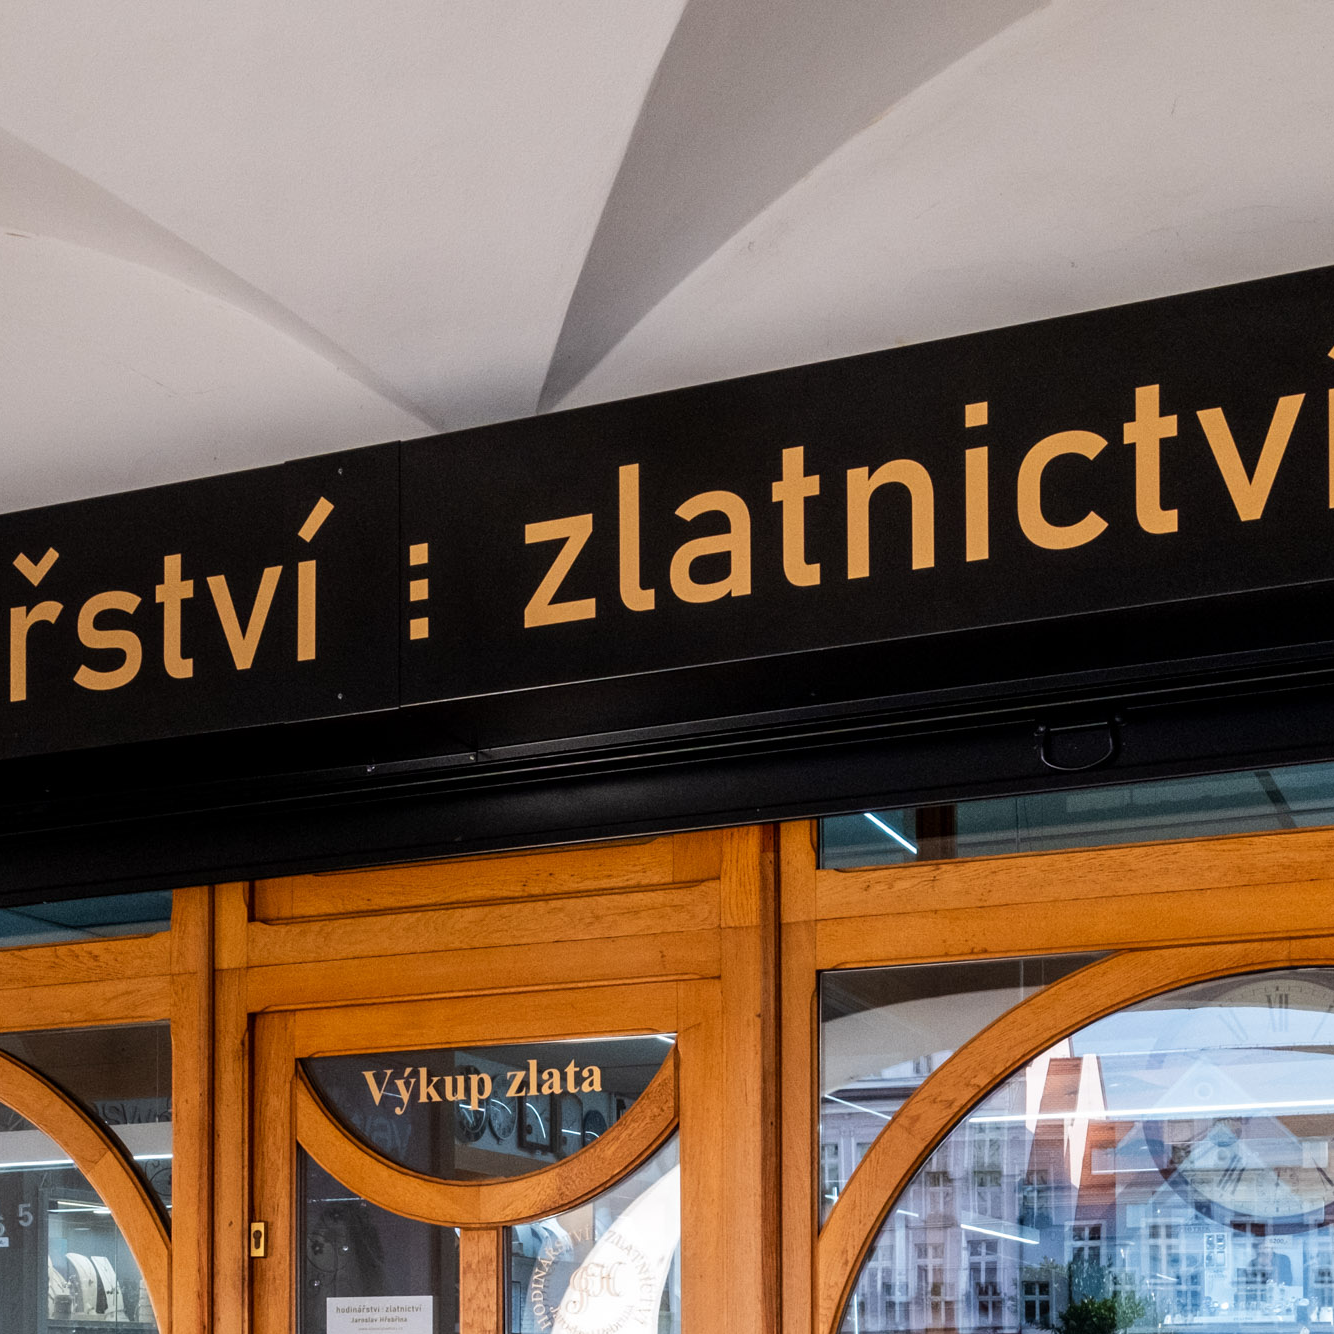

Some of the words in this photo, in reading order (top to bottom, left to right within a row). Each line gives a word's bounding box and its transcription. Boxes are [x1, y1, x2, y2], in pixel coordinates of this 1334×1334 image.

[362, 1067, 492, 1115] Výkup
[506, 1059, 602, 1097] zlata
[18, 1204, 33, 1227] 5
